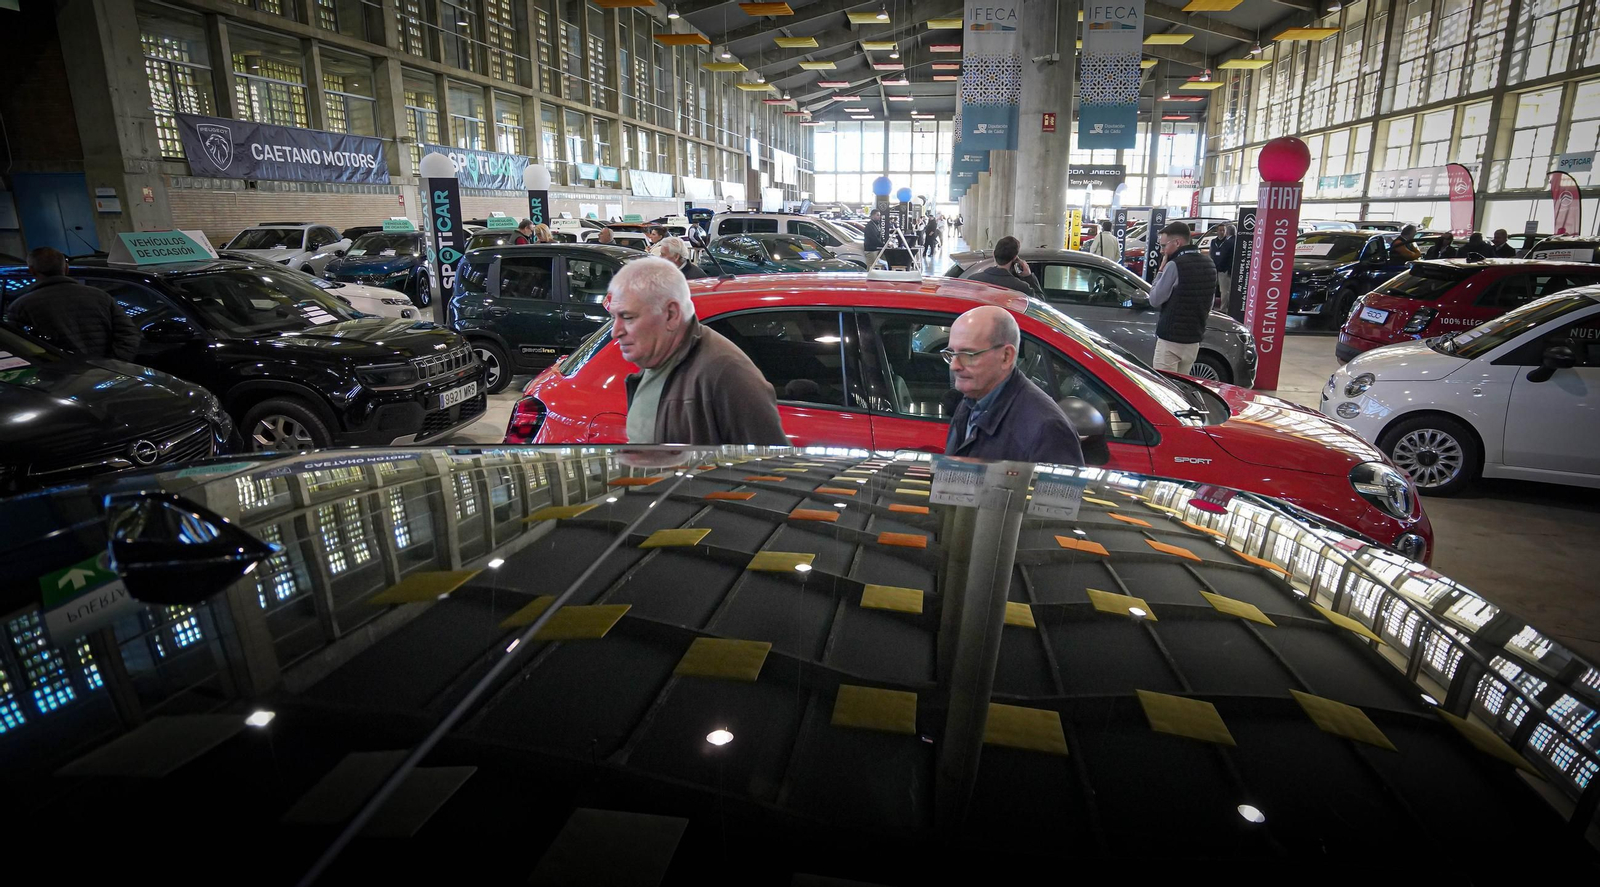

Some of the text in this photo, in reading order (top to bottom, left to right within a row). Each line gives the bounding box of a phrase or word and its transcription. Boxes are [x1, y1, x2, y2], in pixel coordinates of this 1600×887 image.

[970, 7, 1017, 20] IFECA
[1089, 6, 1138, 19] IFECA
[199, 127, 229, 135] PEUGEOT
[251, 143, 376, 168] CAETANO MOTORS
[1257, 187, 1270, 209] FIAT
[1269, 187, 1301, 210] FIAT
[129, 236, 186, 247] VEHÍCULOS
[136, 246, 195, 258] DE OCASIÓN
[1252, 218, 1264, 281] MOTORS
[1260, 218, 1289, 353] CAETANO MOTORS
[1440, 317, 1460, 325] 100%
[445, 389, 463, 405] 9921
[1174, 456, 1213, 464] SPORT
